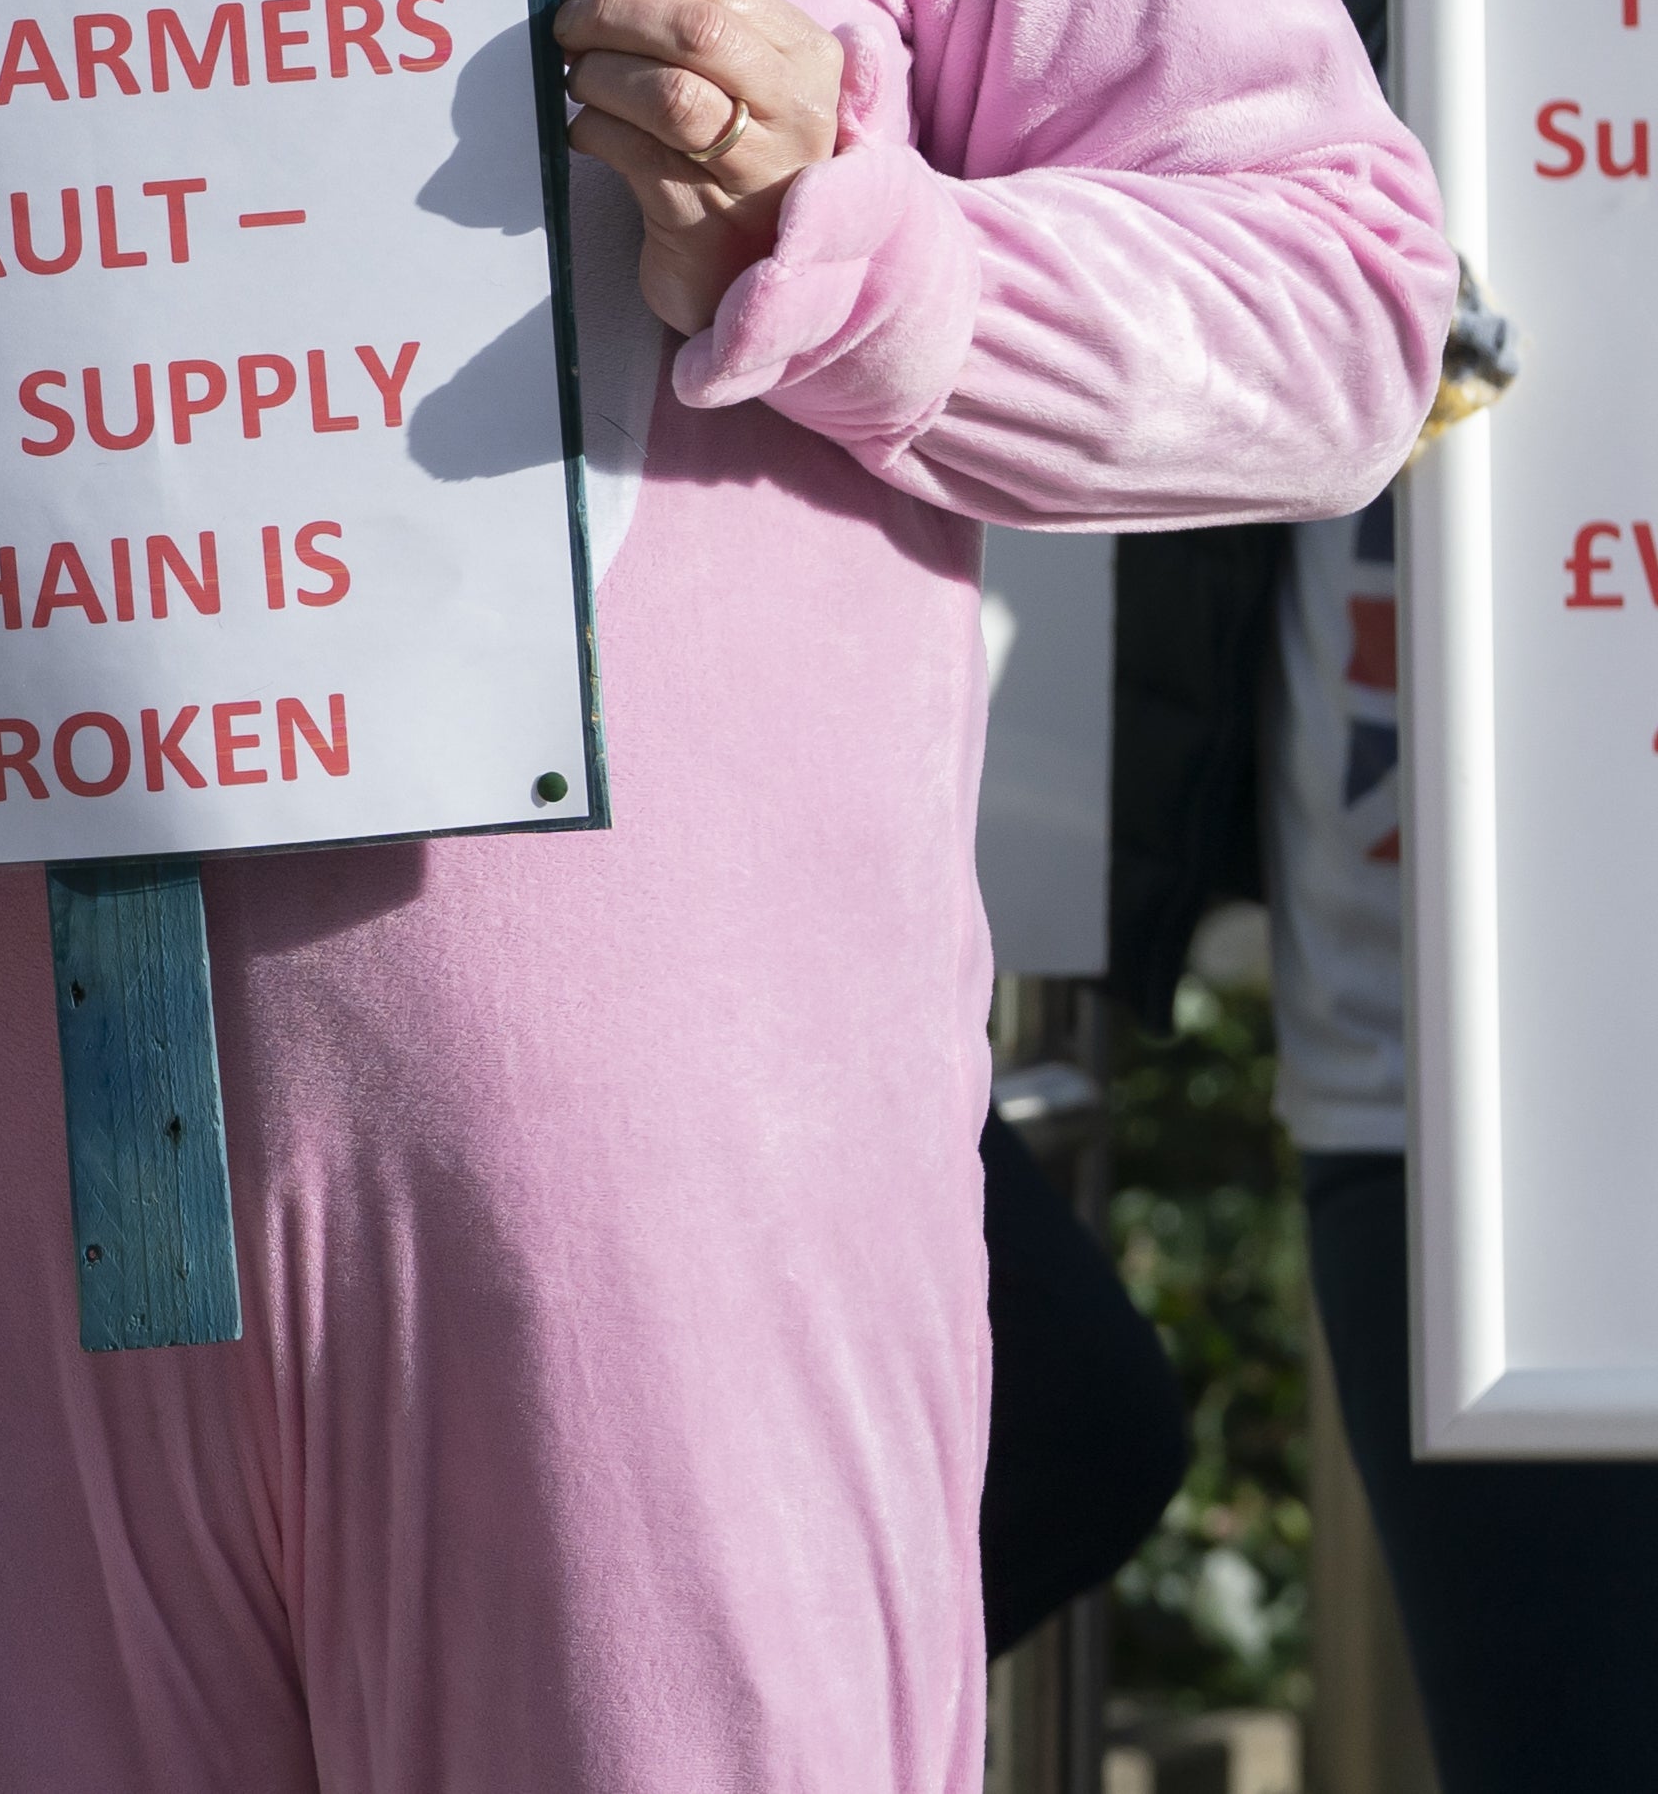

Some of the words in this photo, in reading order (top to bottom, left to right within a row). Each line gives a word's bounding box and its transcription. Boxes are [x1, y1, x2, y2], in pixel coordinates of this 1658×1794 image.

[1535, 99, 1650, 181] Su
[19, 341, 420, 457] SUPPLY
[261, 520, 351, 610] IS
